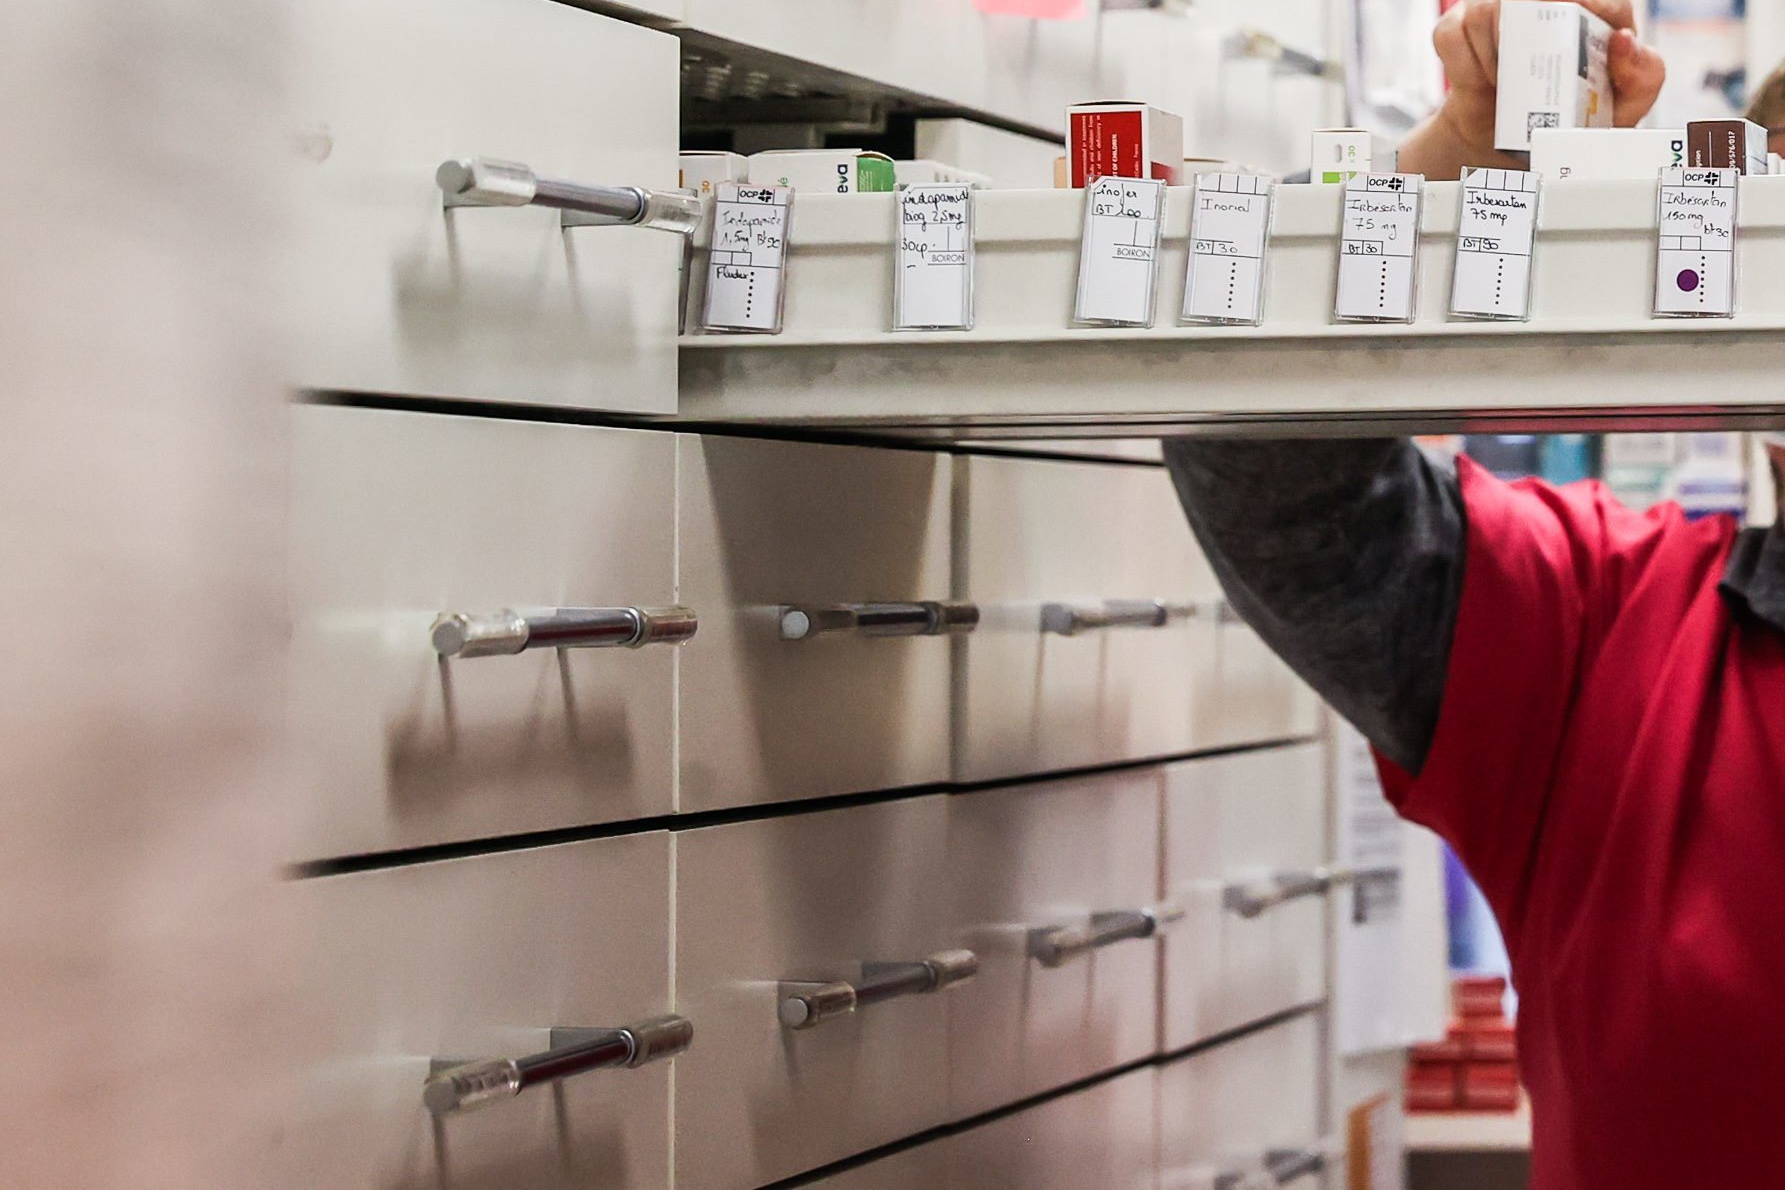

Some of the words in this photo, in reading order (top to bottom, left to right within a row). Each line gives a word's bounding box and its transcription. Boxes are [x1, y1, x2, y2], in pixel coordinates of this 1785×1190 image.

[1685, 173, 1704, 181] OCP
[739, 190, 758, 198] OCP
[1096, 204, 1114, 215] BT
[1117, 248, 1150, 258] BOIRON
[1219, 244, 1238, 253] 30
[932, 253, 965, 262] BOIRON
